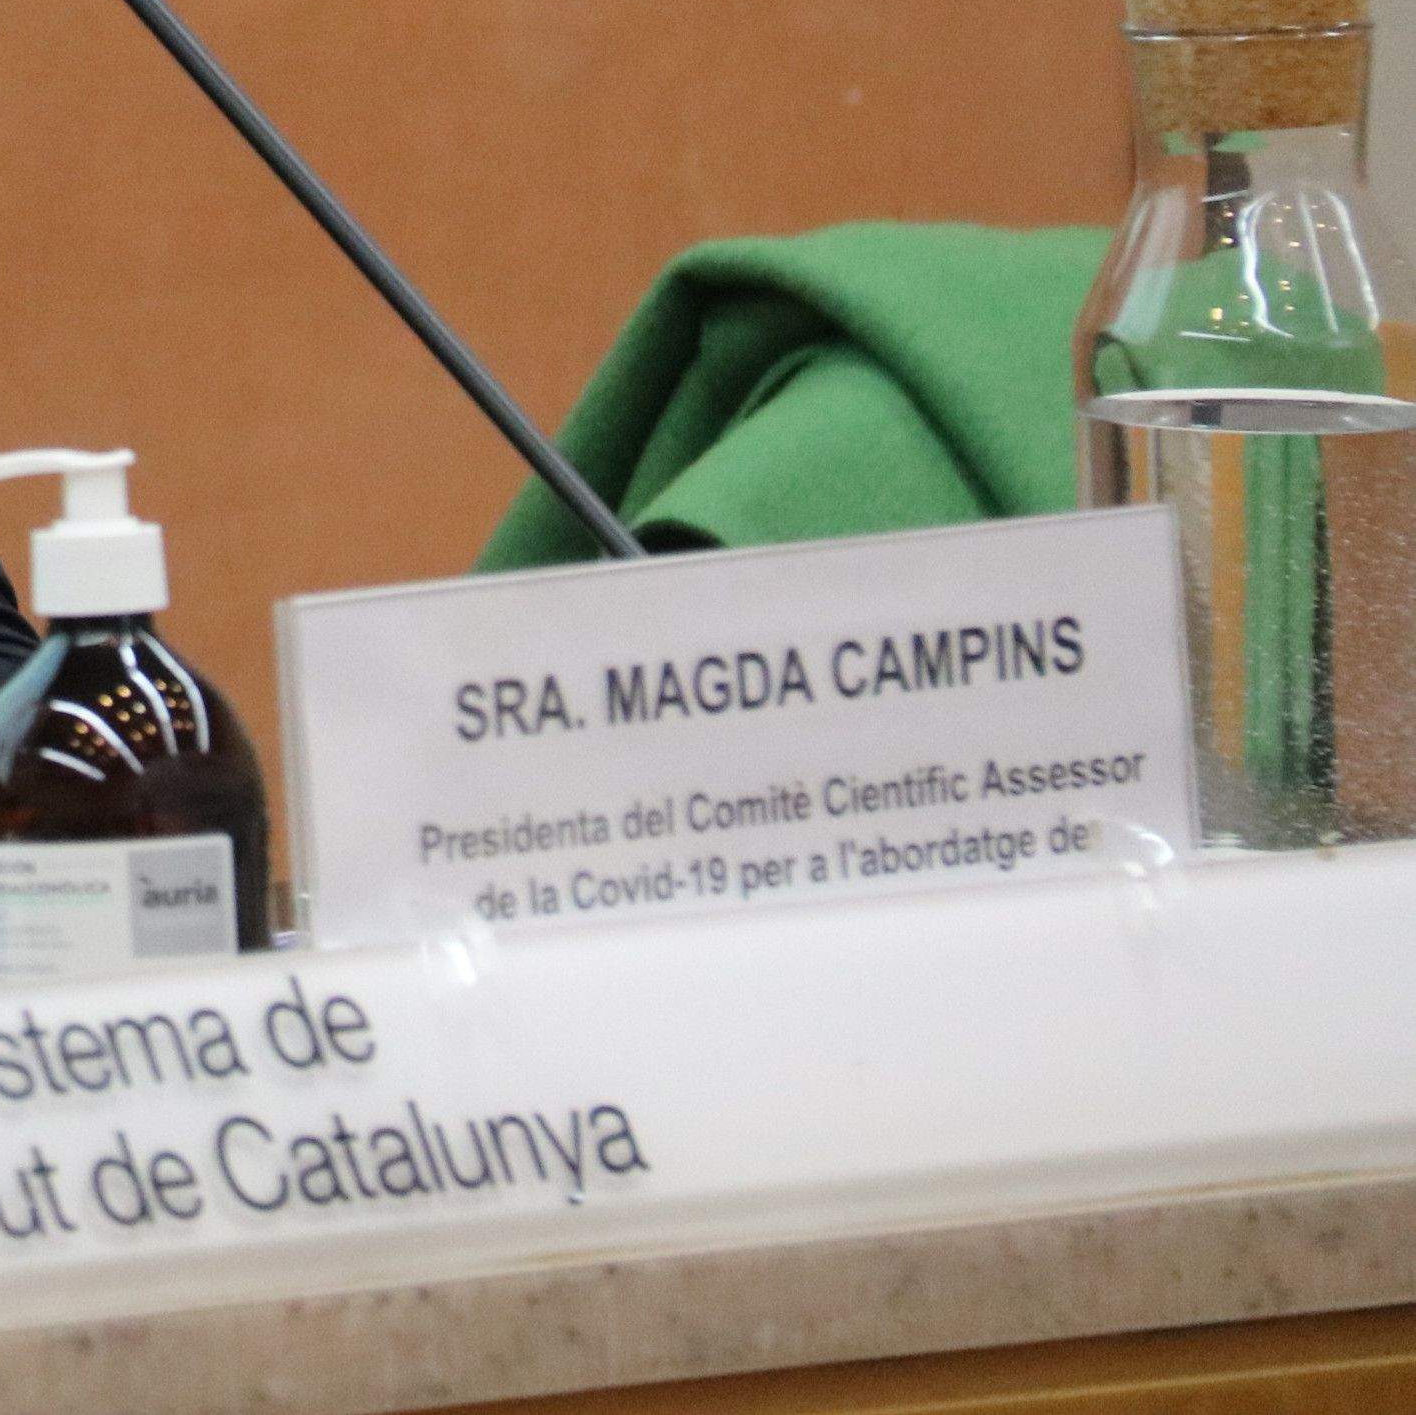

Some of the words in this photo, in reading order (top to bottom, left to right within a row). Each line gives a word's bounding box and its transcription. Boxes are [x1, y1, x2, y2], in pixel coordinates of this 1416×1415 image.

[455, 672, 585, 742] SRA.
[605, 647, 815, 724] MAGDA
[831, 615, 1085, 699] CAMPINS
[420, 810, 610, 864] Presidenta
[622, 797, 676, 841] del
[980, 751, 1145, 799] Assessor
[474, 883, 518, 921] de
[529, 878, 562, 916] la
[571, 854, 728, 909] Covid-19
[739, 855, 797, 900] per
[809, 854, 829, 882] a
[837, 826, 1036, 880] l'abordatge
[265, 975, 377, 1070] de
[93, 1130, 204, 1227] de
[215, 1100, 649, 1212] Catalunya
